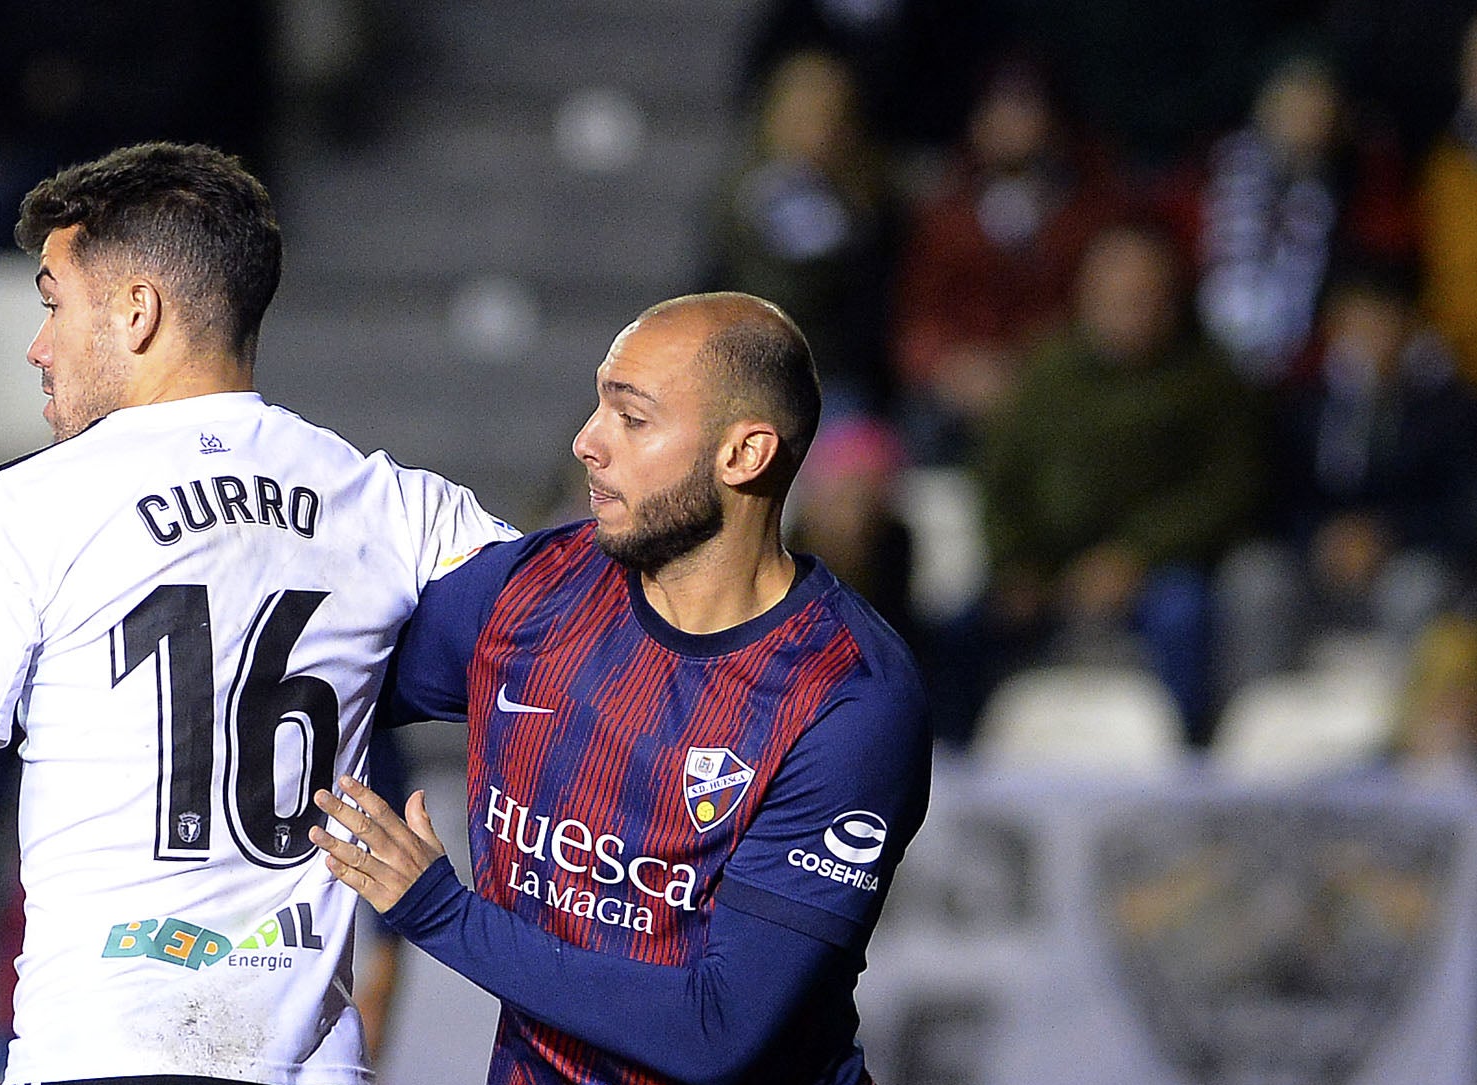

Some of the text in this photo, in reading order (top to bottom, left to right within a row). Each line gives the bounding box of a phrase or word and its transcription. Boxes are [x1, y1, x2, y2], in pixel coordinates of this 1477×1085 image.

[135, 474, 319, 546] CURRO
[109, 583, 340, 870] 16
[507, 860, 541, 900] La
[787, 848, 880, 892] COSEHISA
[228, 951, 293, 971] Energía
